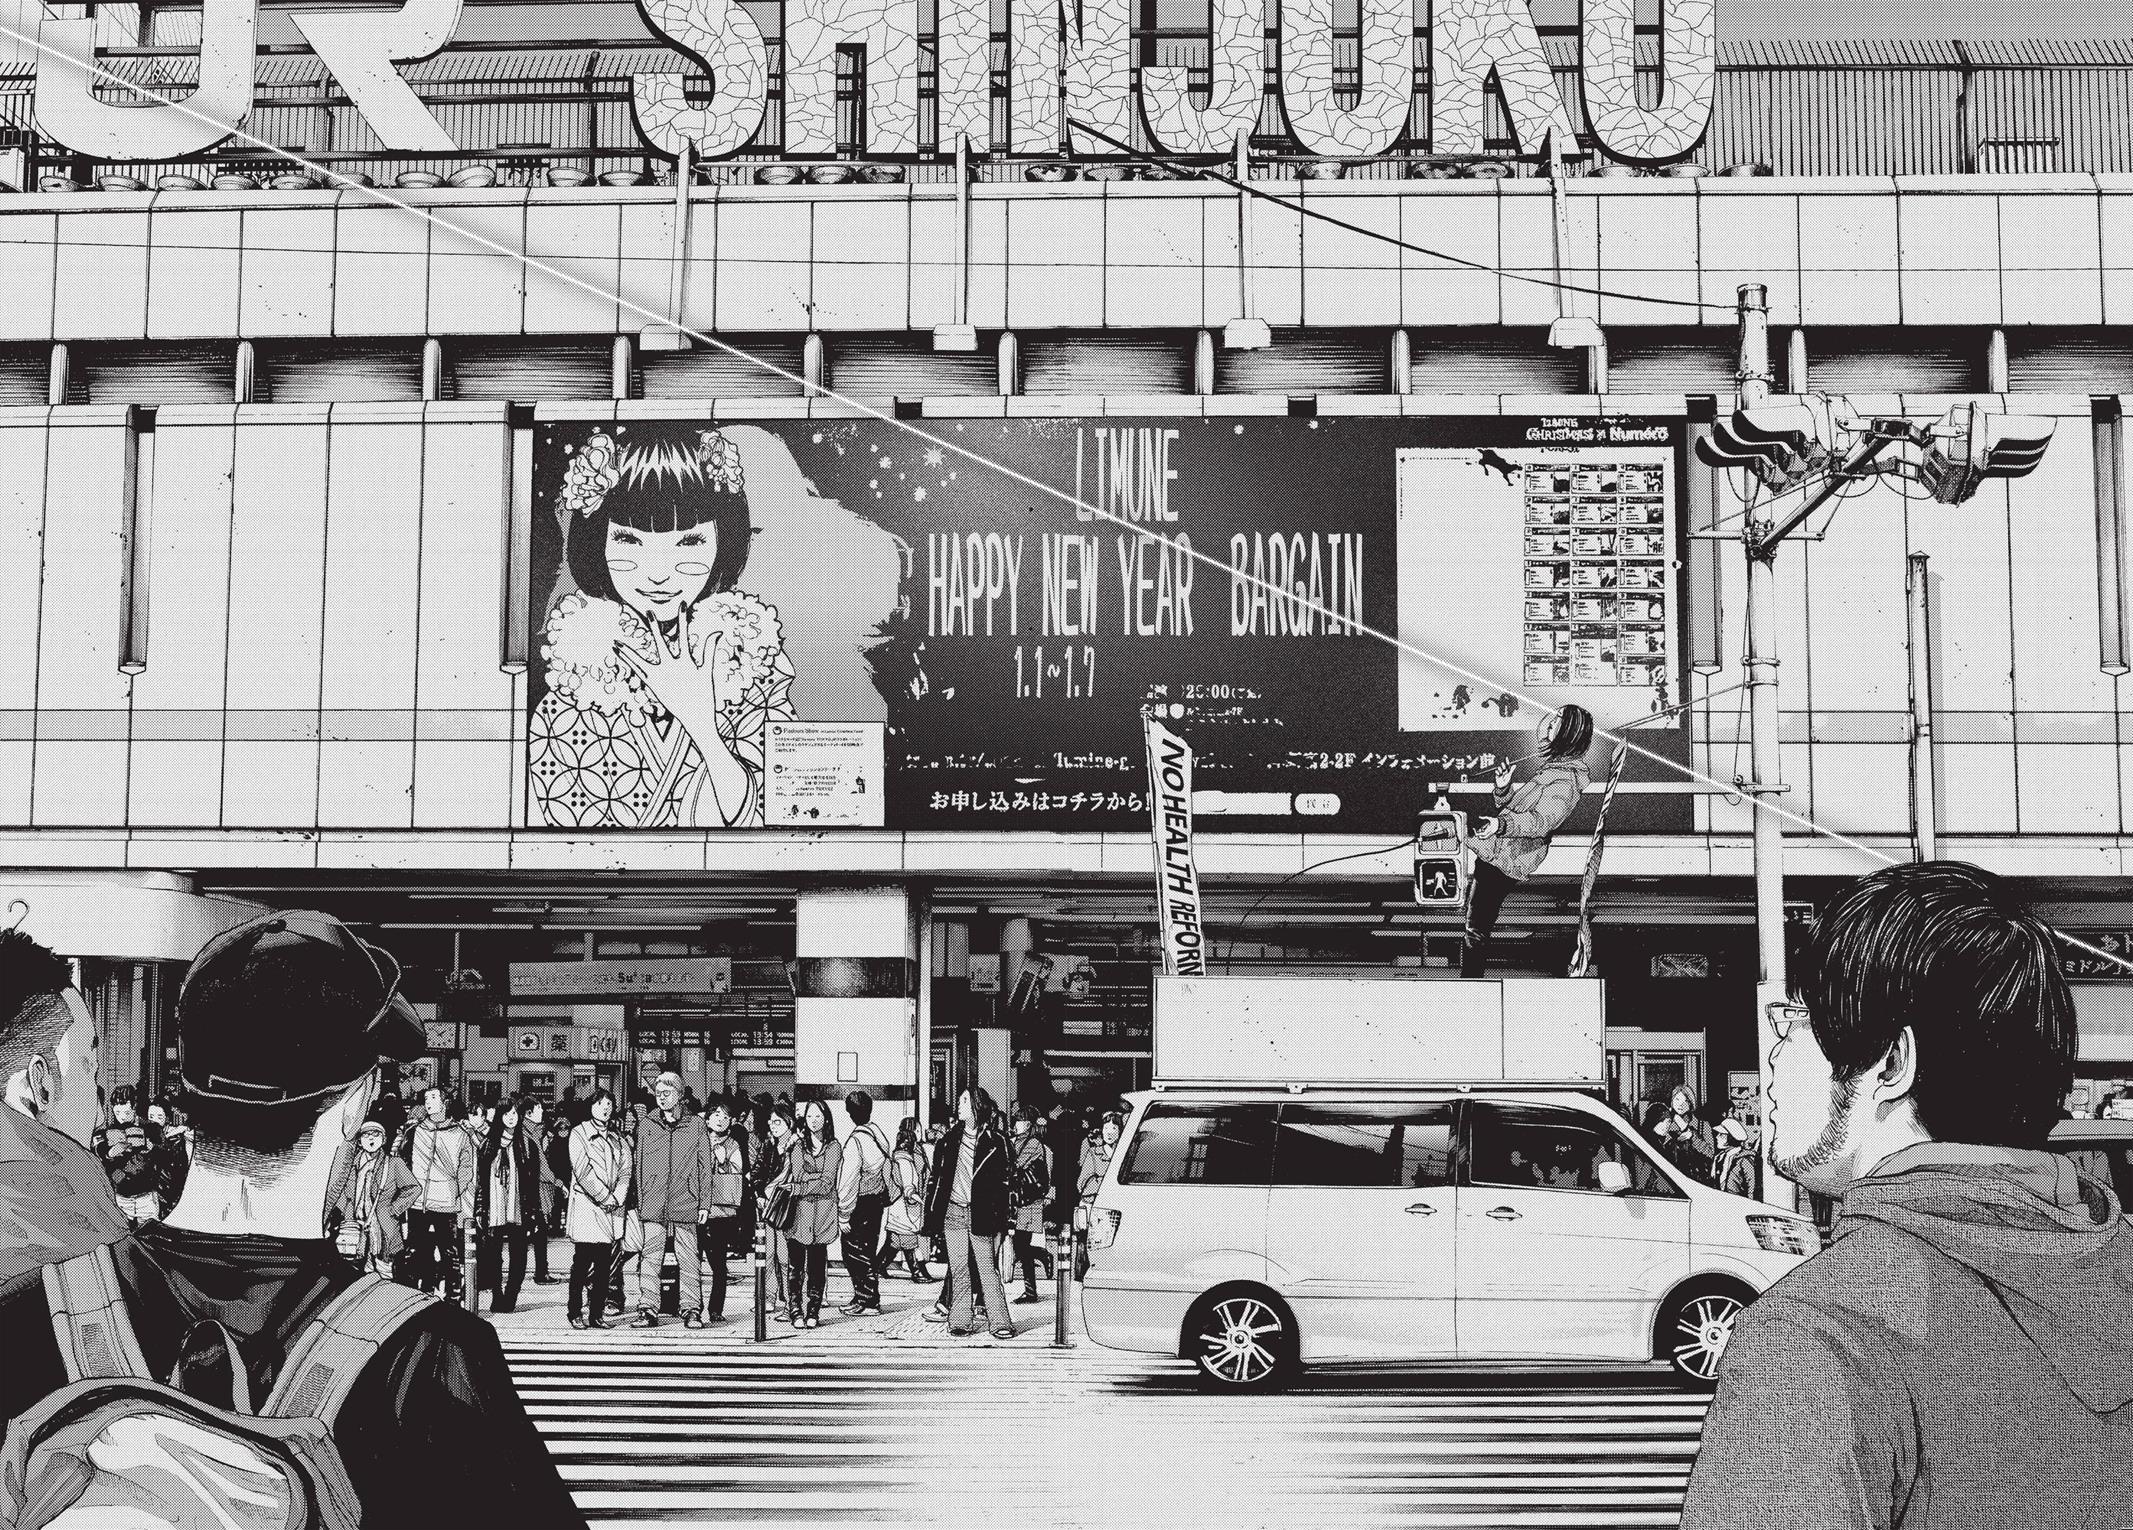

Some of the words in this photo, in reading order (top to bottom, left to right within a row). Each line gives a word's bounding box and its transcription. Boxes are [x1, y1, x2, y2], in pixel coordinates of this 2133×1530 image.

[1076, 427, 1180, 522] LIMUNE
[928, 531, 1023, 636] HAPPY
[1042, 532, 1099, 636] NEW
[1117, 531, 1194, 636] YEAR
[1230, 531, 1363, 636] BARGAIN
[1162, 794, 1194, 896] HEALTH
